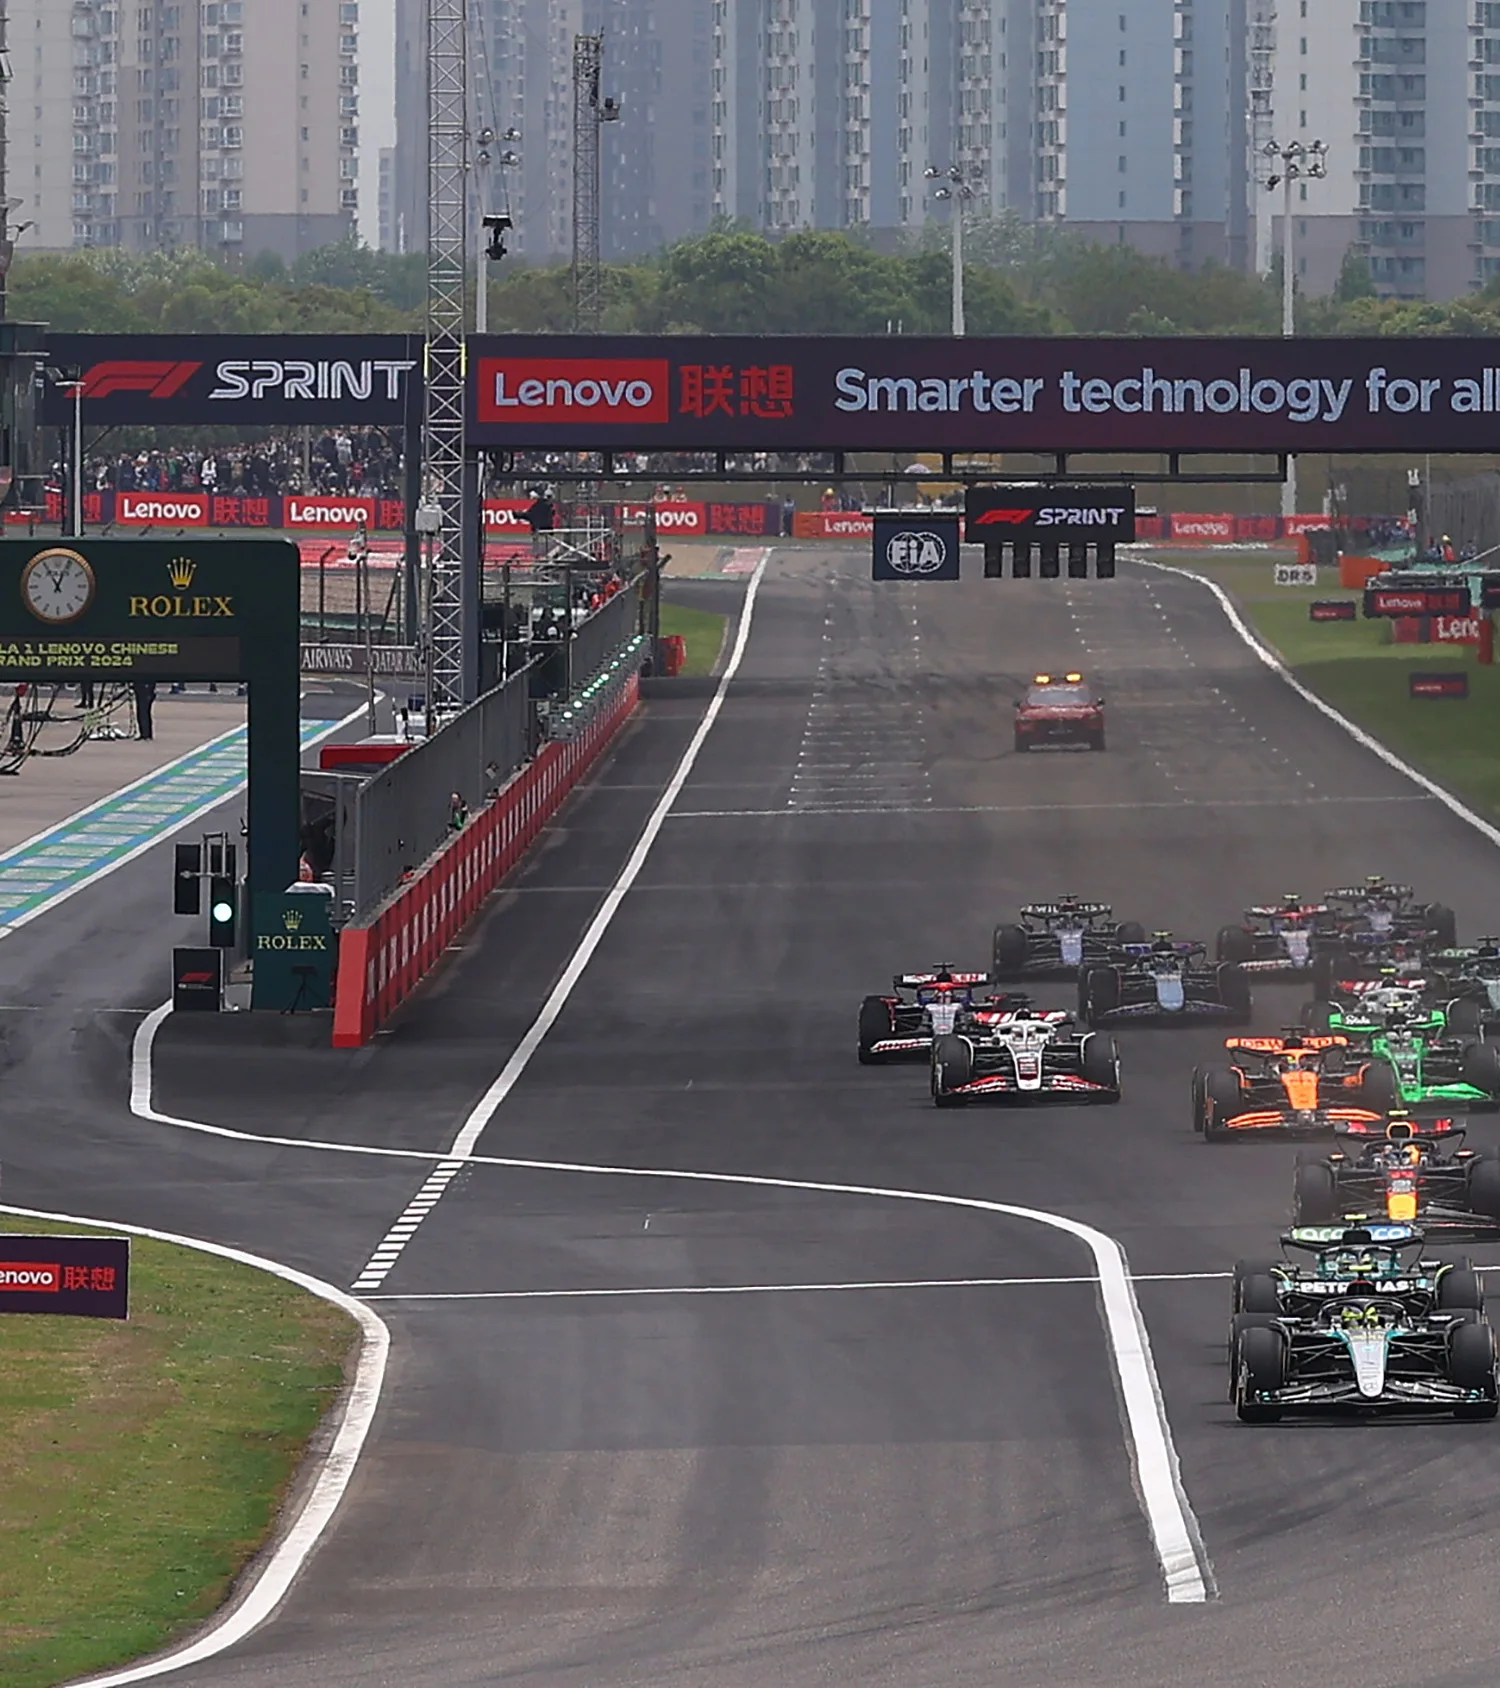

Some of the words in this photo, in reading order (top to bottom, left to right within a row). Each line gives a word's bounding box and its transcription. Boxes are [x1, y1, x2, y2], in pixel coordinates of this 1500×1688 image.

[209, 360, 417, 399] SPRINT
[494, 371, 653, 408] Lenovo
[678, 364, 794, 419] 联想
[834, 367, 1044, 414] Smarter
[1059, 367, 1352, 422] technology
[1365, 367, 1441, 414] for
[123, 498, 202, 519] Lenovo
[290, 501, 368, 523] Lenovo
[710, 504, 765, 534] 联想
[1035, 507, 1126, 526] SPRINT
[824, 518, 874, 533] Lenov
[129, 596, 235, 617] ROLEX
[39, 643, 106, 655] LENOVO
[111, 643, 179, 655] CHINESE
[301, 647, 353, 670] AIRWAYS
[0, 655, 42, 667] RAND
[47, 655, 85, 667] PRIX
[90, 655, 133, 667] 2024
[257, 935, 327, 950] ROLEX
[63, 1265, 116, 1292] 联想
